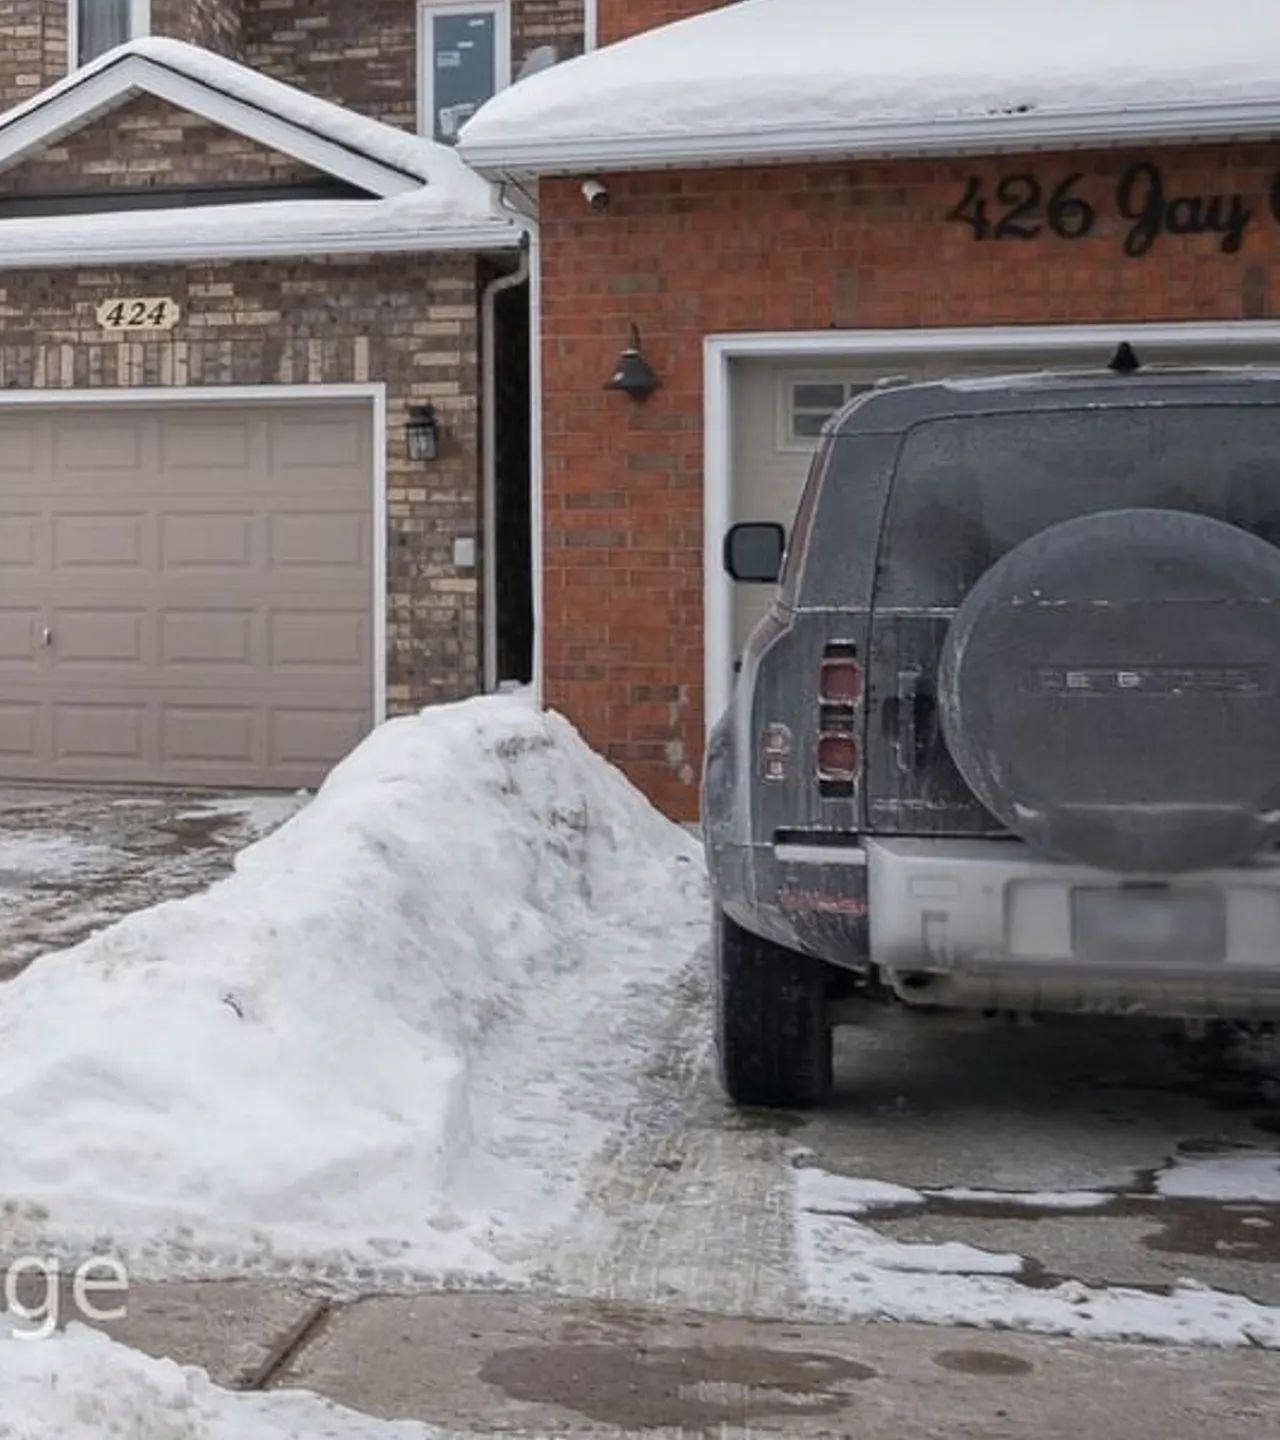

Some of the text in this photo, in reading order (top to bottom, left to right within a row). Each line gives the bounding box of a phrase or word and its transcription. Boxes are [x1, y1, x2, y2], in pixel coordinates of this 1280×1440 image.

[945, 172, 1096, 241] 426
[1116, 162, 1251, 257] Jay
[106, 301, 167, 326] 424
